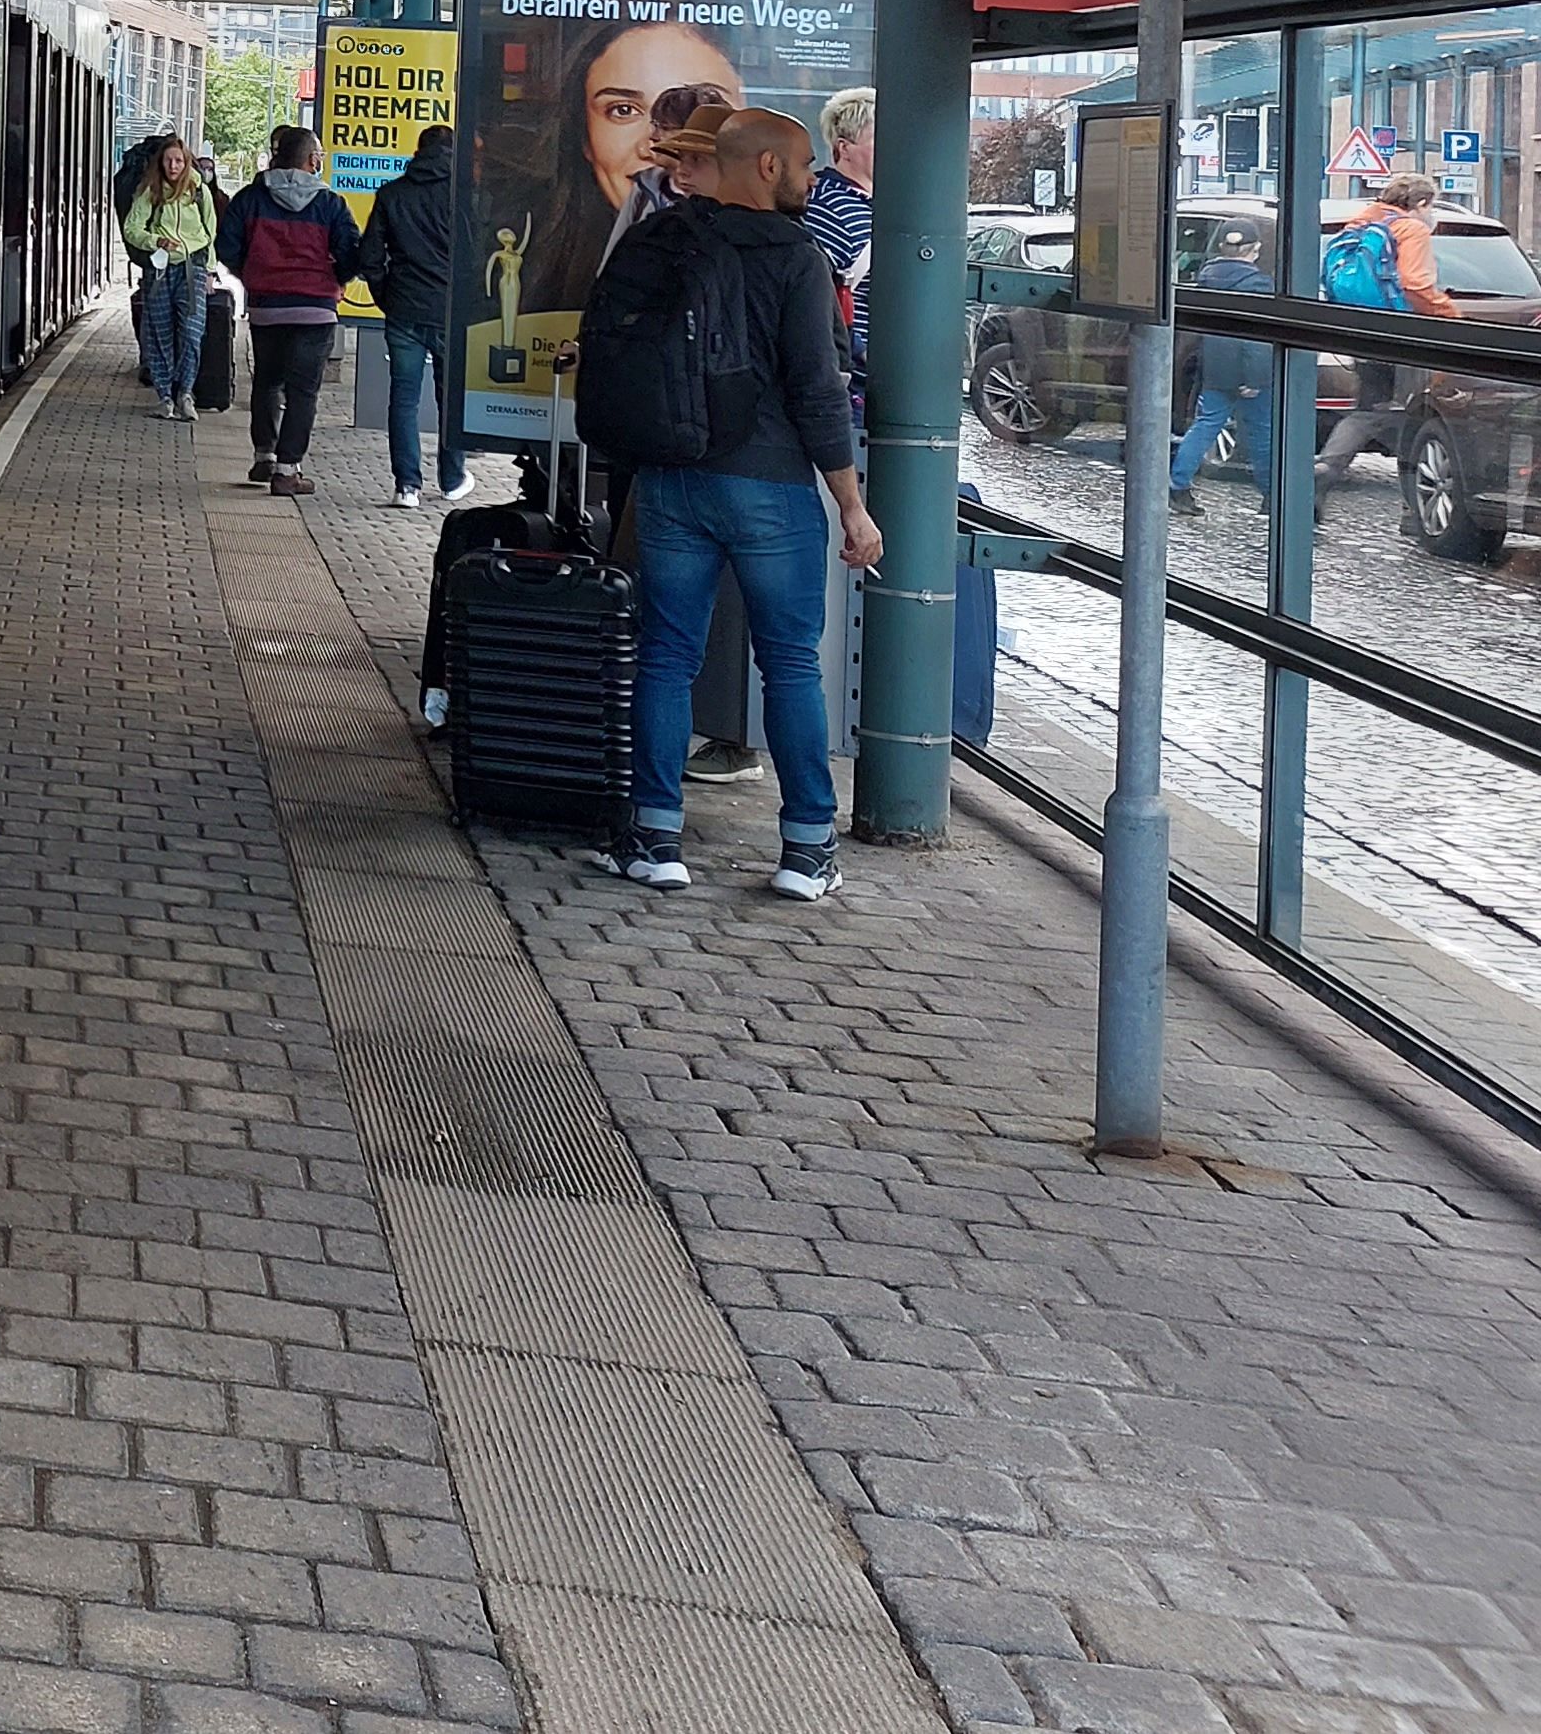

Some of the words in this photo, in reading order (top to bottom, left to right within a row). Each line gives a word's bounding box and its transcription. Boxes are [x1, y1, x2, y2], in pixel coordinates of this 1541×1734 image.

[678, 3, 744, 25] neue
[334, 65, 389, 90] HOL
[398, 67, 445, 93] DIR
[333, 94, 451, 123] BREMEN
[332, 123, 399, 149] RAD!
[1450, 134, 1472, 159] P
[337, 155, 391, 170] RICHTIG
[532, 337, 555, 353] Die
[485, 404, 549, 418] DERMASENCE
